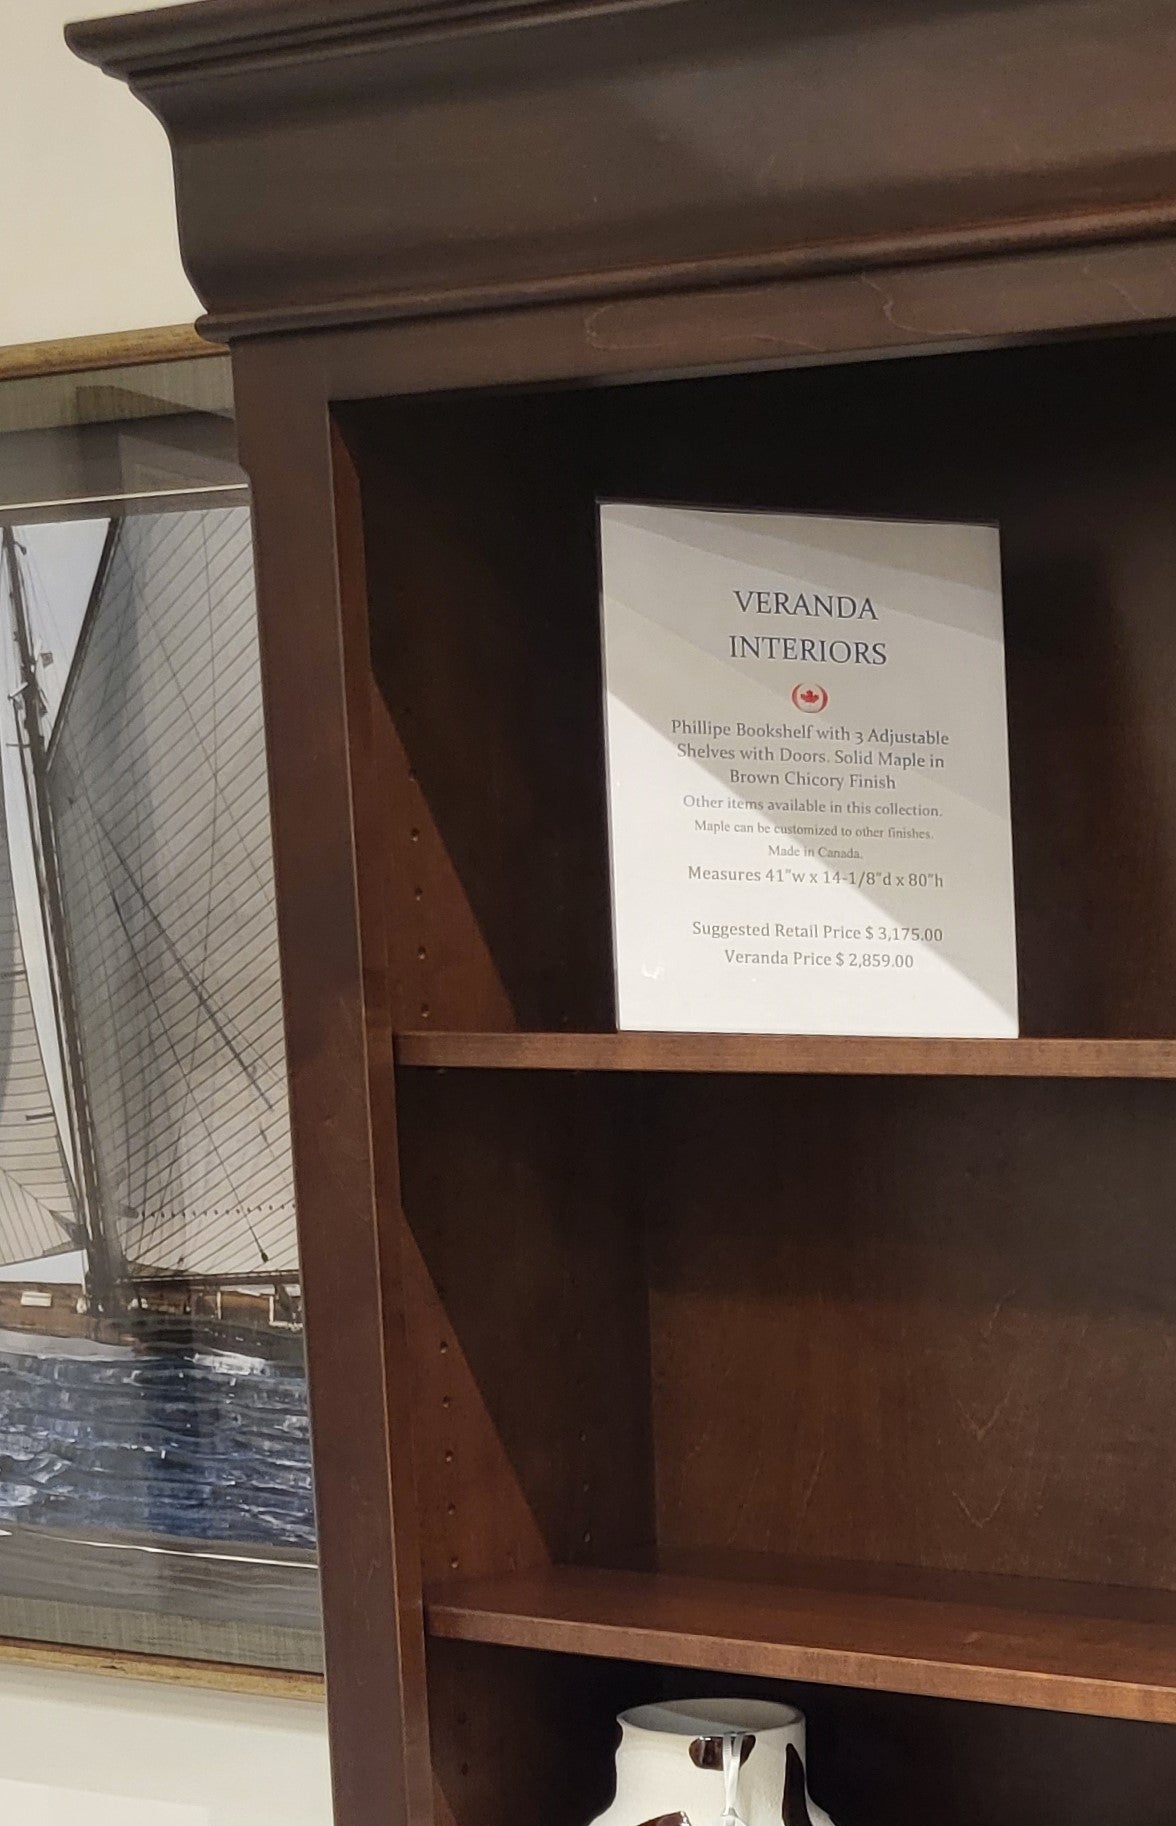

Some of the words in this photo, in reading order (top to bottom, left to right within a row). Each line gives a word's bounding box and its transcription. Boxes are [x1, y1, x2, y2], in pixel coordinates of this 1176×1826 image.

[733, 590, 878, 620] VERANDA
[729, 635, 887, 665] INTERIORS
[671, 720, 731, 738] Phillipe
[736, 723, 815, 740] Bookshelf
[816, 726, 850, 742] with
[855, 731, 864, 745] 3
[868, 728, 950, 747] Adjustable
[676, 744, 736, 762] Shelves
[740, 746, 774, 762] with
[780, 748, 830, 764] Doors.
[835, 750, 873, 766] Solid
[878, 752, 925, 770] Maple
[930, 753, 945, 768] in
[730, 769, 780, 786] Brown
[785, 771, 844, 790] Chicory
[849, 774, 896, 790] Finish
[683, 794, 724, 810] Other
[727, 797, 764, 812] items
[767, 798, 826, 814] available
[830, 801, 843, 814] in
[847, 801, 871, 815] this
[875, 802, 943, 817] collection.
[694, 819, 730, 834] Maple
[734, 823, 754, 834] can
[757, 821, 771, 834] be
[774, 822, 837, 837] customized
[841, 825, 852, 837] to
[855, 825, 884, 838] other
[888, 826, 934, 839] finishes.
[768, 844, 800, 858] Made
[804, 846, 815, 858] in
[818, 846, 863, 859] Canada.
[688, 865, 761, 882] Measures
[765, 867, 806, 884] 41"w
[809, 872, 818, 883] x
[823, 869, 892, 888] 14-1/8"d
[895, 875, 904, 886] x
[908, 872, 944, 888] 80"h
[692, 921, 770, 941] Suggested
[775, 923, 818, 939] Retail
[823, 925, 862, 940] Price
[865, 925, 874, 941] $
[877, 926, 943, 943] 3,175.00
[724, 949, 789, 966] Veranda
[793, 951, 832, 967] Price
[835, 952, 844, 968] $
[848, 953, 914, 970] 2,859.00
